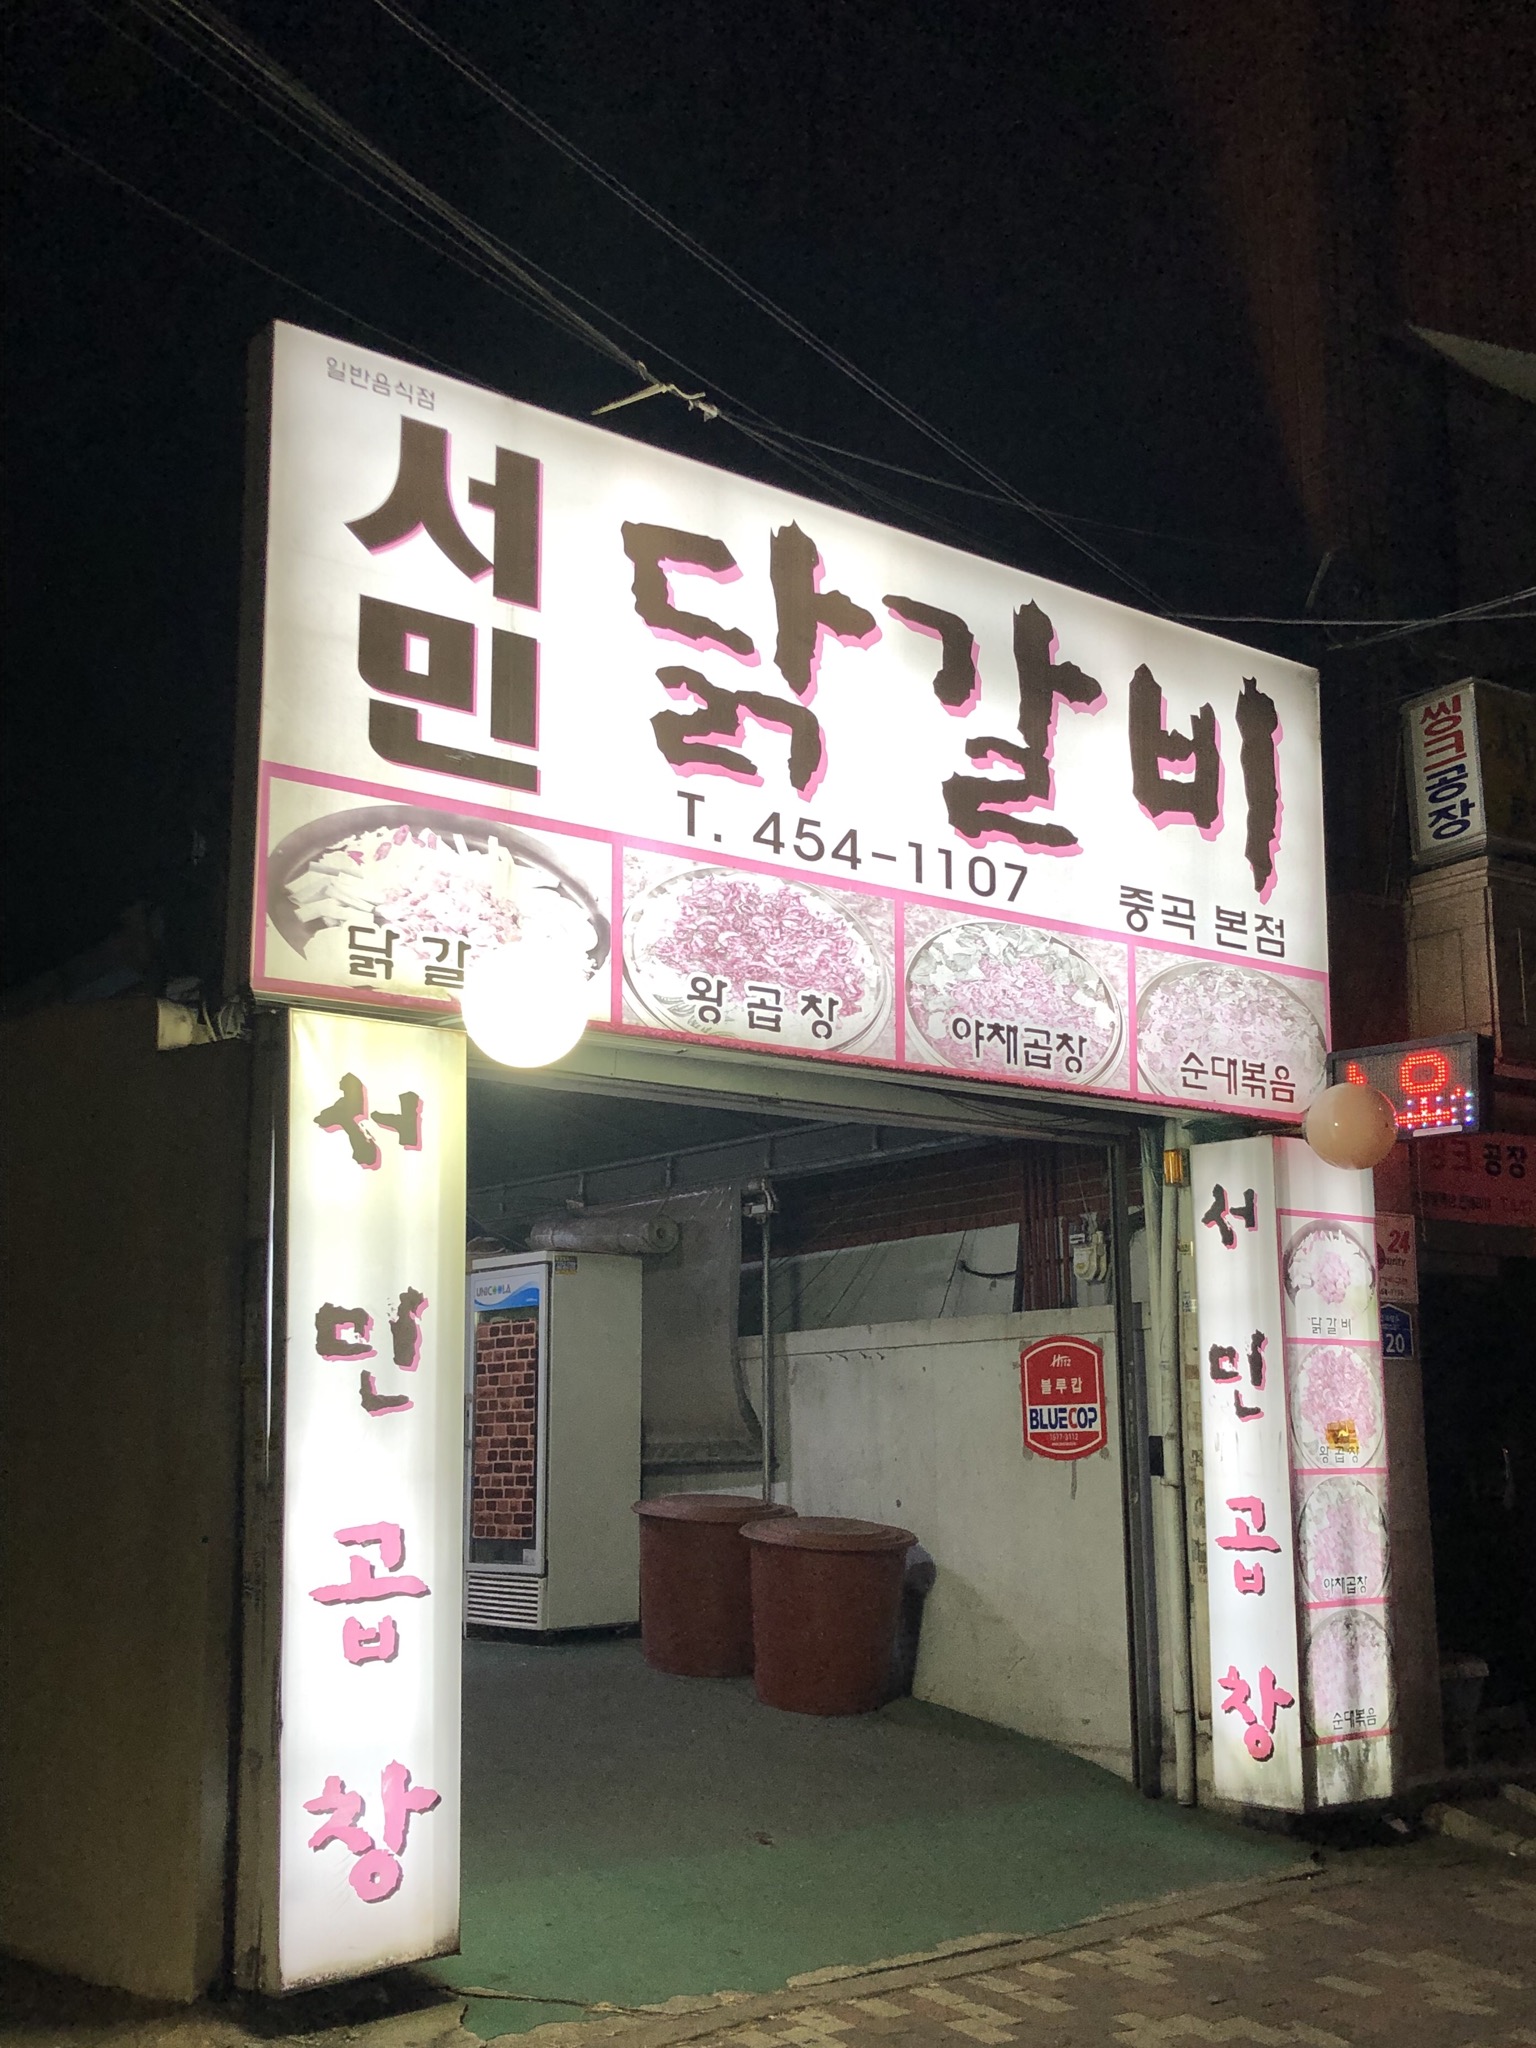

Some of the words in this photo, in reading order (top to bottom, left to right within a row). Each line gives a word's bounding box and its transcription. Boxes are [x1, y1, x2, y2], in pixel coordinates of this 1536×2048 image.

[325, 356, 436, 412] 일반음식점
[344, 414, 542, 795] 서민
[620, 519, 1284, 904] 닭갈비
[1419, 693, 1476, 841] 씽크공장
[677, 790, 722, 843] T.
[752, 811, 1028, 902] 454-1107
[1119, 884, 1196, 941] 중곡
[1214, 905, 1285, 959] 본점
[348, 925, 472, 990] 닭갈
[686, 976, 839, 1041] 왕곱창
[951, 1015, 1088, 1075] 야채곱창
[1180, 1051, 1296, 1104] 순대볶음
[1387, 1230, 1411, 1255] 24
[1310, 1316, 1352, 1336] 닭갈비
[1385, 1333, 1406, 1354] 20
[1041, 1377, 1083, 1395] 블루캅
[1029, 1407, 1098, 1430] BLUECOP
[1323, 1576, 1368, 1595] 야채곱창
[1332, 1706, 1377, 1730] 순대볶음
